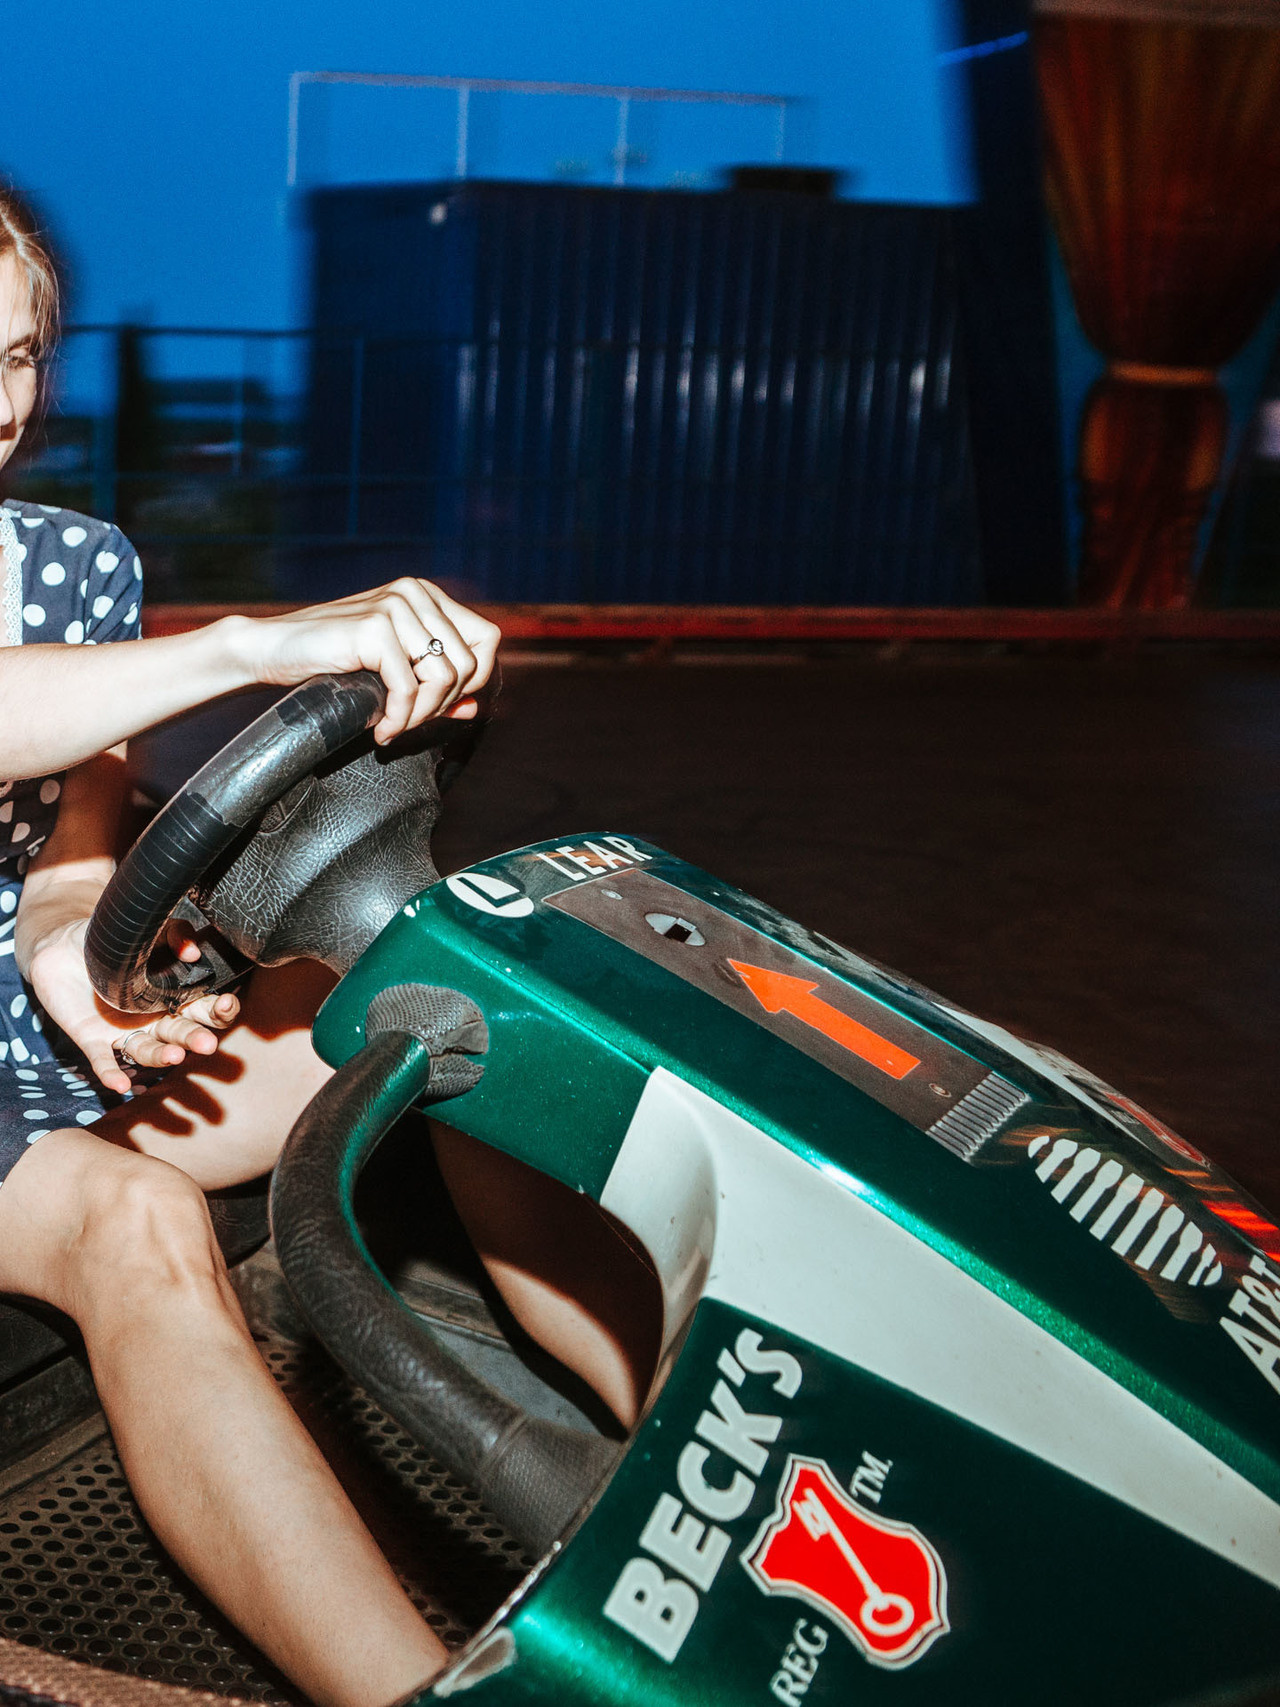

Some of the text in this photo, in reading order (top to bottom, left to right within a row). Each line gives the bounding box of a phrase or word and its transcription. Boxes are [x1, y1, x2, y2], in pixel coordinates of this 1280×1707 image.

[536, 836, 653, 882] LEAR
[602, 1328, 804, 1664] BECK'S
[769, 1617, 829, 1707] REG
